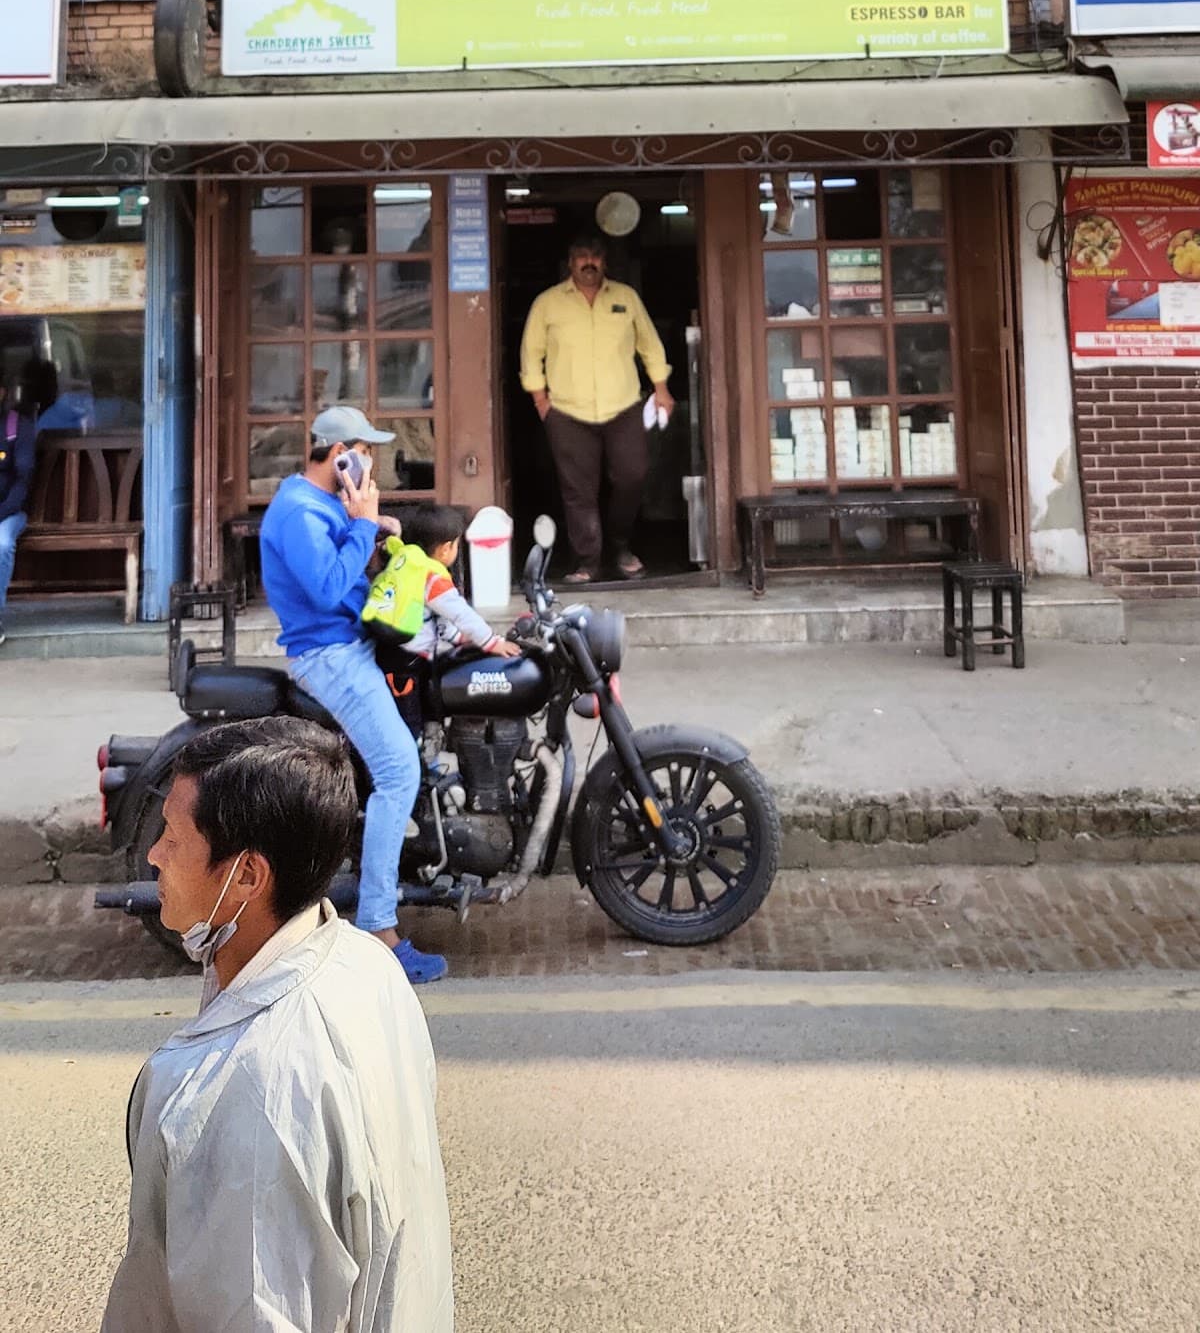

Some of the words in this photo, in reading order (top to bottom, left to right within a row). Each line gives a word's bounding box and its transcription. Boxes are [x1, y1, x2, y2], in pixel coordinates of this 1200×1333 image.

[850, 6, 928, 20] ESPRESSO
[935, 5, 965, 19] BAR
[248, 36, 322, 54] CHANDRAYAN
[329, 34, 371, 48] SWEETS
[1074, 181, 1125, 202] SMART
[1130, 180, 1200, 204] PANIPURI
[471, 671, 508, 683] ROYAL
[468, 682, 512, 695] ENFIELD
